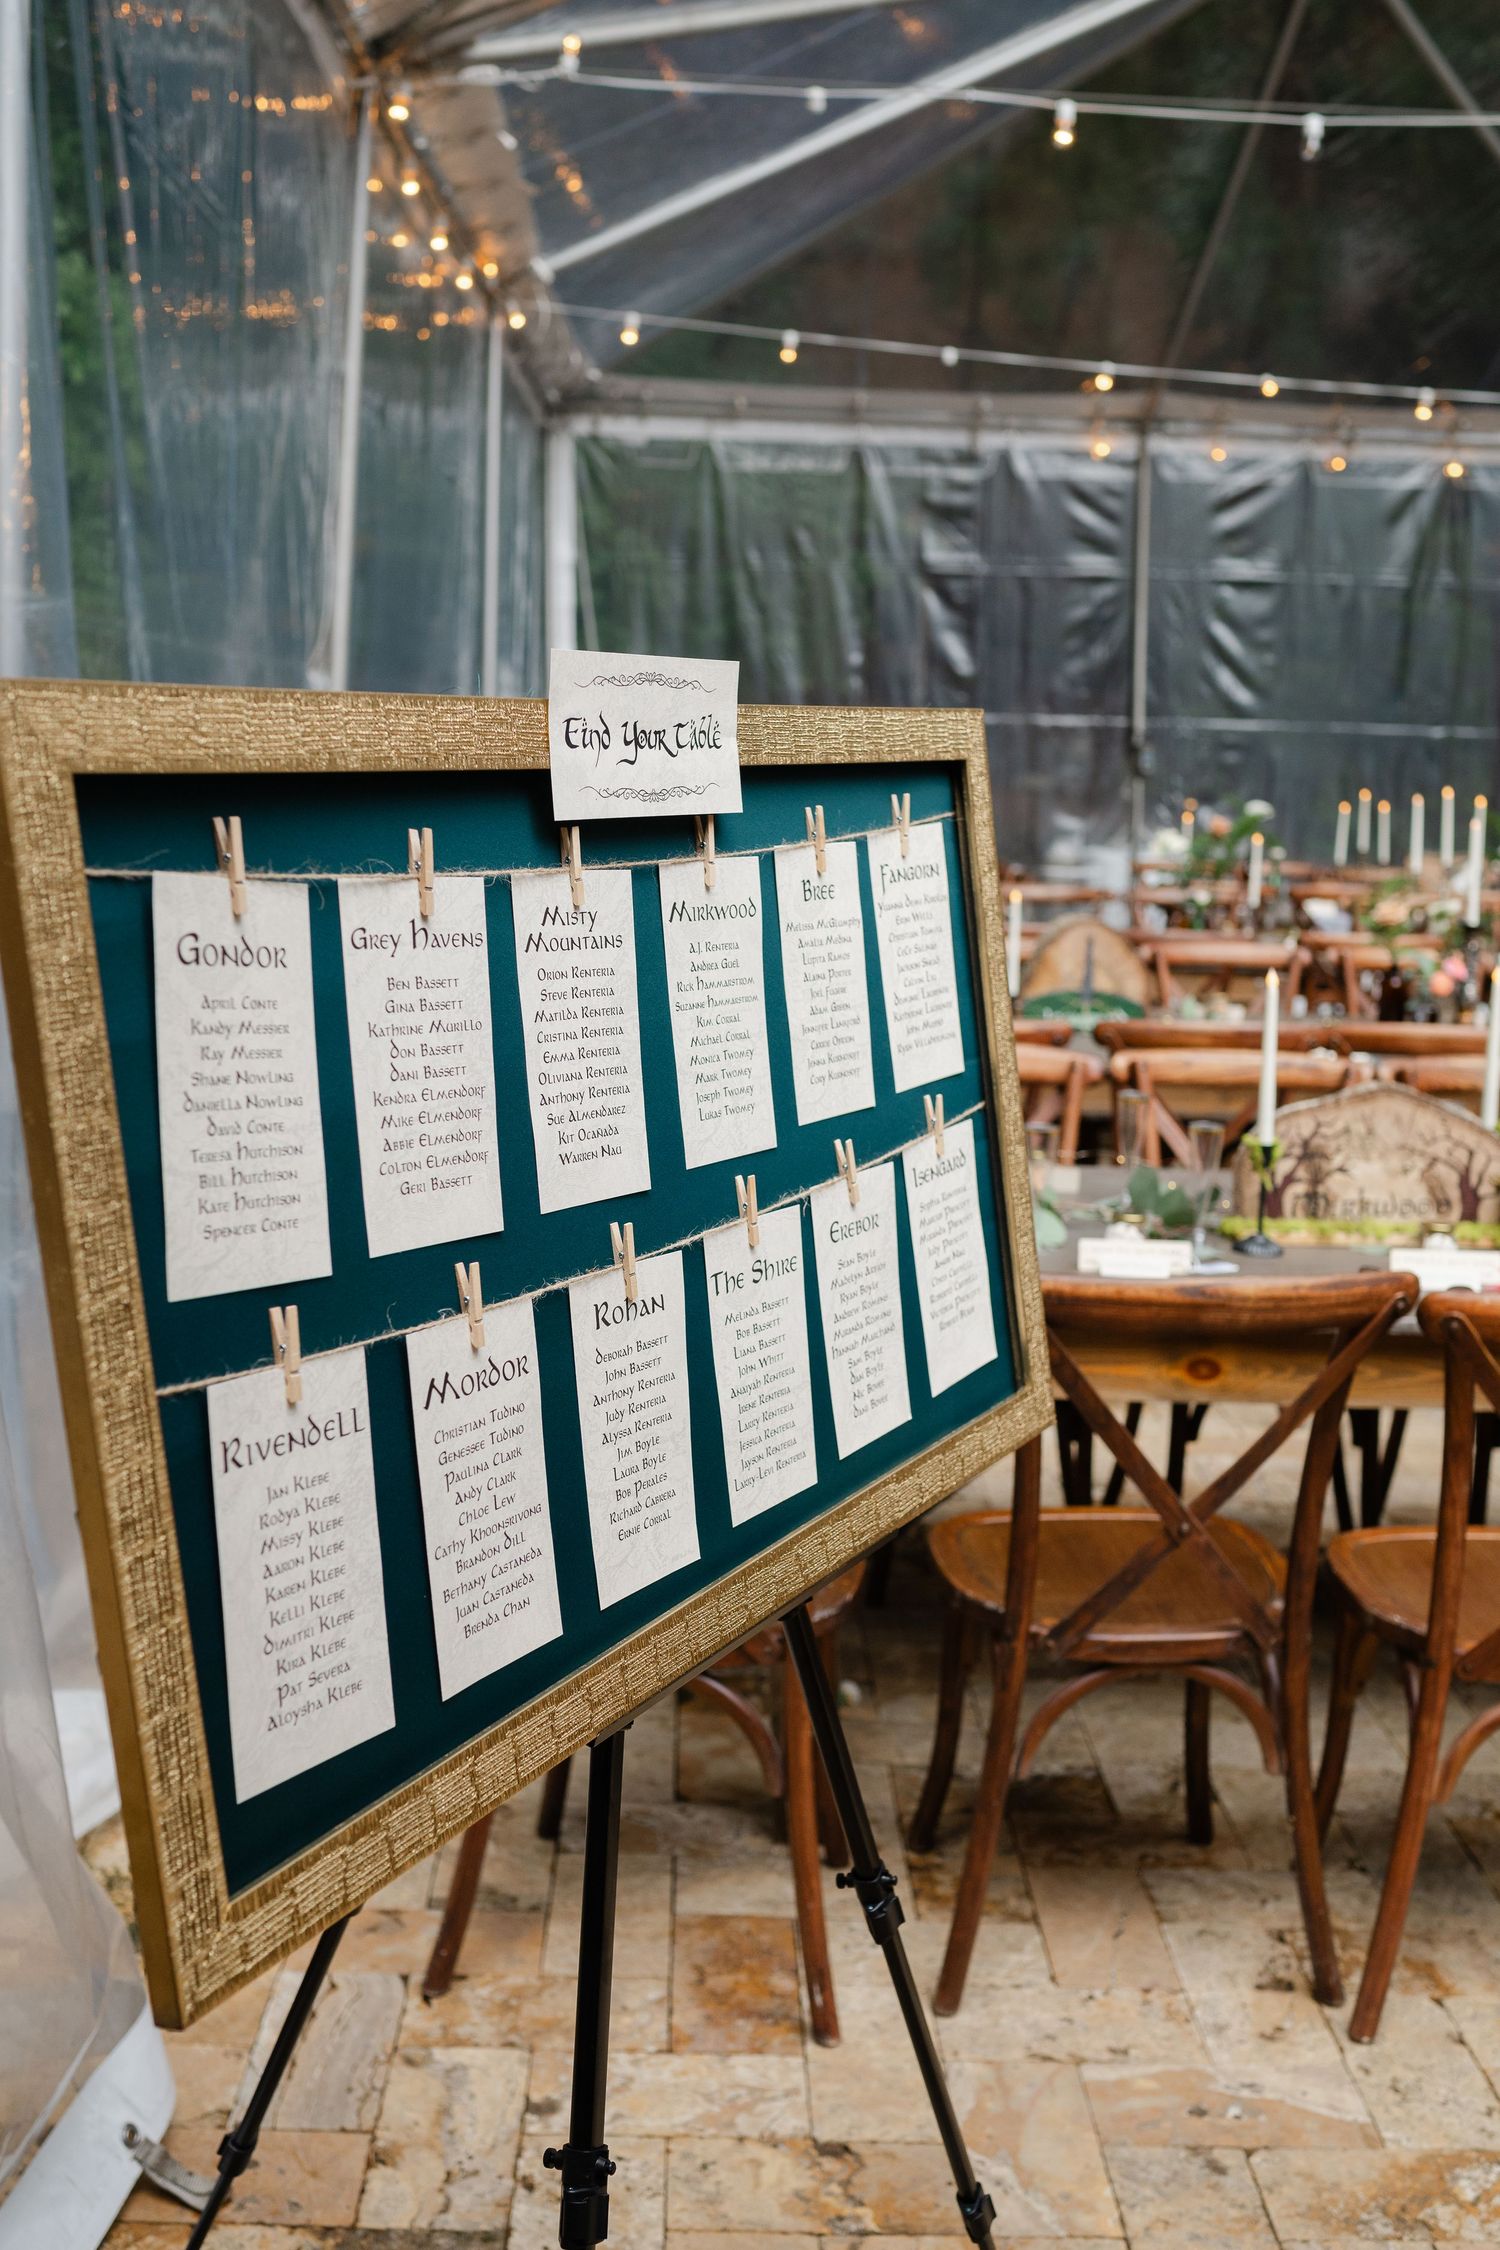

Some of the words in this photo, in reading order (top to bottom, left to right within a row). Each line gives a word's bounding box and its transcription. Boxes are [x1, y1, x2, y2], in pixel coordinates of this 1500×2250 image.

[563, 711, 611, 767] Find
[616, 720, 678, 766] Your
[673, 714, 723, 750] Table
[802, 880, 834, 902] Bree
[541, 906, 597, 932] Misty
[669, 898, 756, 923] Mirkwood
[177, 933, 286, 968] Gondor
[351, 928, 401, 957] Grey
[410, 919, 483, 949] Havens
[525, 932, 622, 953] Mountains
[387, 977, 410, 991] Ben
[415, 976, 458, 990] Bassett
[538, 968, 568, 981] Orion
[572, 966, 615, 978] Renteria
[385, 1000, 415, 1013] Gina
[419, 998, 462, 1012] Bassett
[541, 989, 567, 1002] Steve
[571, 986, 614, 999] Renteria
[534, 1008, 578, 1023] Matilda
[581, 1006, 624, 1018] Renteria
[368, 1022, 423, 1038] Kathrine
[429, 1020, 482, 1033] Murillo
[537, 1031, 578, 1043] Cristina
[581, 1026, 624, 1039] Renteria
[390, 1039, 415, 1058] Don
[420, 1043, 463, 1057] Bassett
[544, 1051, 575, 1064] Emma
[578, 1047, 620, 1059] Renteria
[390, 1062, 418, 1082] Dani
[424, 1066, 466, 1079] Bassett
[586, 1066, 628, 1079] Renteria
[374, 1091, 417, 1106] Kendra
[422, 1084, 486, 1101] Elmendorf
[540, 1091, 584, 1106] Anthony
[588, 1085, 630, 1099] Renteria
[381, 1115, 413, 1129] Mike
[418, 1107, 482, 1124] Elmendorf
[547, 1113, 564, 1126] Sue
[384, 1138, 414, 1152] Abbie
[419, 1129, 482, 1147] Elmendorf
[558, 1131, 574, 1144] Kit
[380, 1161, 422, 1176] Colton
[426, 1150, 488, 1168] Elmendorf
[559, 1150, 598, 1165] Warren
[601, 1144, 622, 1157] Nau
[400, 1182, 426, 1195] Geri
[431, 1175, 472, 1191] Bassett
[830, 1214, 879, 1243] Erebor
[710, 1271, 744, 1296] The
[752, 1255, 798, 1284] Shire
[594, 1294, 664, 1330] Rohan
[596, 1345, 632, 1364] Deborah
[636, 1336, 667, 1352] Bassett
[424, 1356, 529, 1410] Mordor
[605, 1368, 626, 1385] John
[630, 1357, 661, 1374] Bassett
[594, 1386, 634, 1407] Anthony
[638, 1372, 675, 1391] Renteria
[606, 1408, 625, 1425] Judy
[628, 1395, 666, 1415] Renteria
[434, 1418, 486, 1444] Christian
[490, 1403, 525, 1422] Tudino
[489, 1425, 524, 1444] Tudino
[602, 1428, 632, 1445] Alyssa
[635, 1413, 672, 1432] Renteria
[222, 1408, 366, 1473] Rivendell
[617, 1448, 632, 1462] Jim
[635, 1436, 659, 1452] Boyle
[444, 1462, 489, 1492] Paulina
[493, 1448, 522, 1466] Clark
[613, 1465, 640, 1481] Laura
[642, 1453, 666, 1470] Boyle
[456, 1486, 482, 1505] Andy
[487, 1472, 516, 1491] Clark
[616, 1488, 631, 1501] Bob
[634, 1473, 667, 1498] Perales
[459, 1505, 489, 1526] Chloe
[493, 1494, 515, 1510] Lew
[610, 1501, 642, 1525] Richard
[645, 1489, 676, 1508] Cabrera
[618, 1524, 640, 1541] Ernie
[644, 1509, 671, 1529] Corral
[435, 1538, 466, 1560] Cathy
[456, 1545, 500, 1574] Brandon
[504, 1530, 526, 1550] Dill
[443, 1574, 487, 1603] Bethany
[492, 1547, 542, 1578] Castaneda
[456, 1601, 479, 1622] Juan
[483, 1573, 534, 1605] Castaneda
[464, 1613, 500, 1638] Brenda
[504, 1597, 530, 1617] Chan
